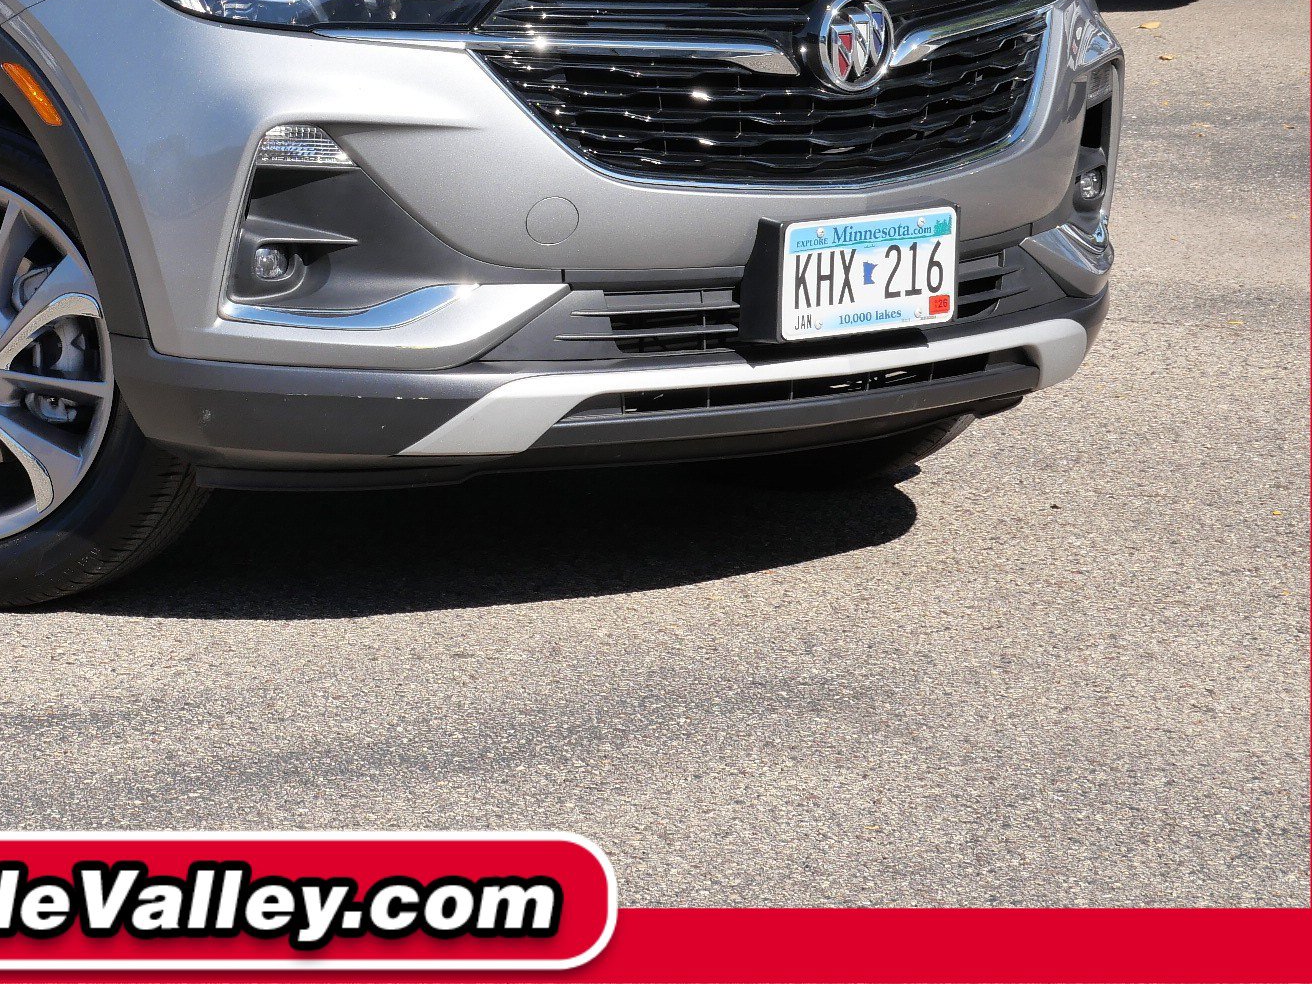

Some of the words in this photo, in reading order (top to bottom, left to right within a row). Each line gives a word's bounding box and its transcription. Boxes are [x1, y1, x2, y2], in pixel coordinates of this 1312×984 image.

[796, 236, 829, 248] EXPLORE
[794, 248, 857, 310] KHX
[884, 239, 944, 300] 216
[794, 313, 813, 331] JAN
[838, 311, 873, 325] 10,000
[875, 308, 902, 322] lakes
